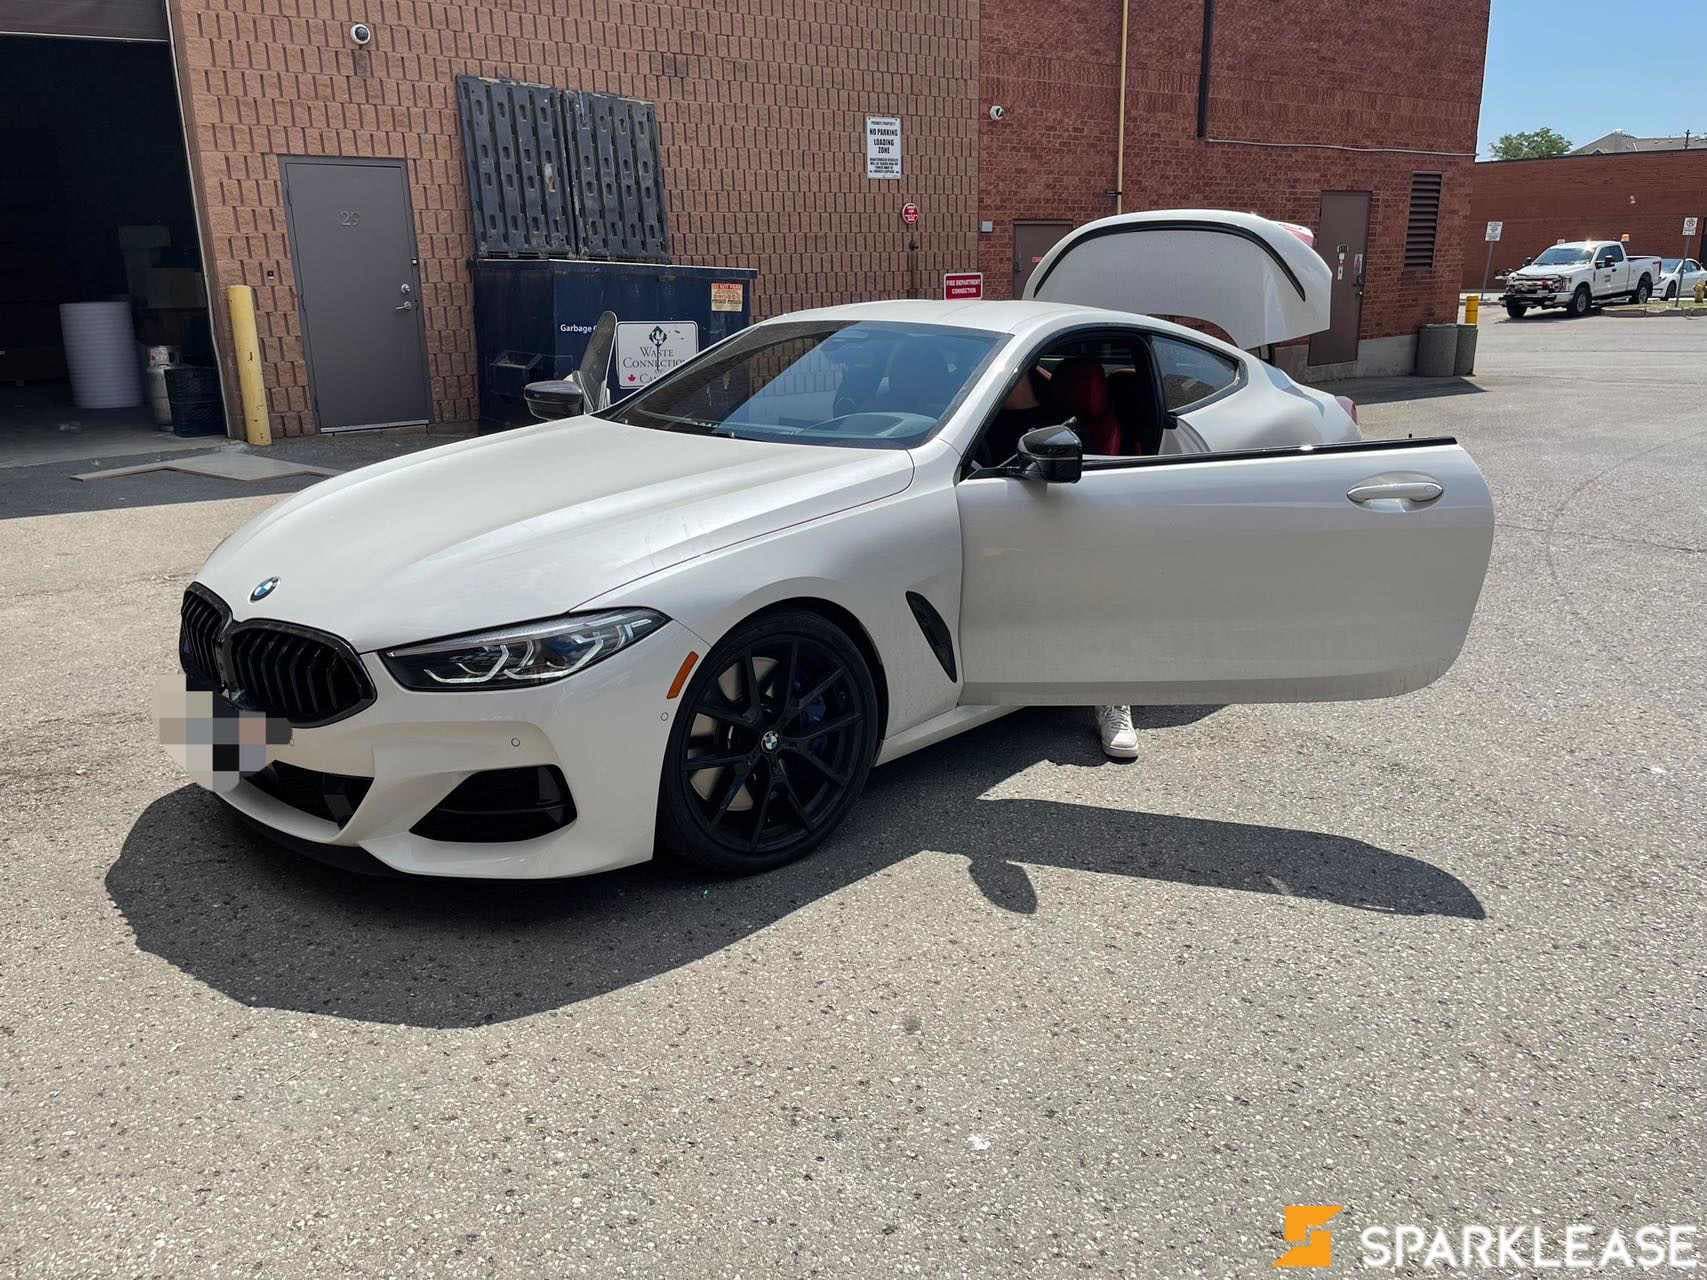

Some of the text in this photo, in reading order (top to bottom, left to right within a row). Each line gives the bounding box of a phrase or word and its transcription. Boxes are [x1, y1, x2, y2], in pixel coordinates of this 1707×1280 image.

[873, 138, 894, 146] LOADING
[560, 324, 592, 334] Garbage
[640, 346, 674, 357] WASTE
